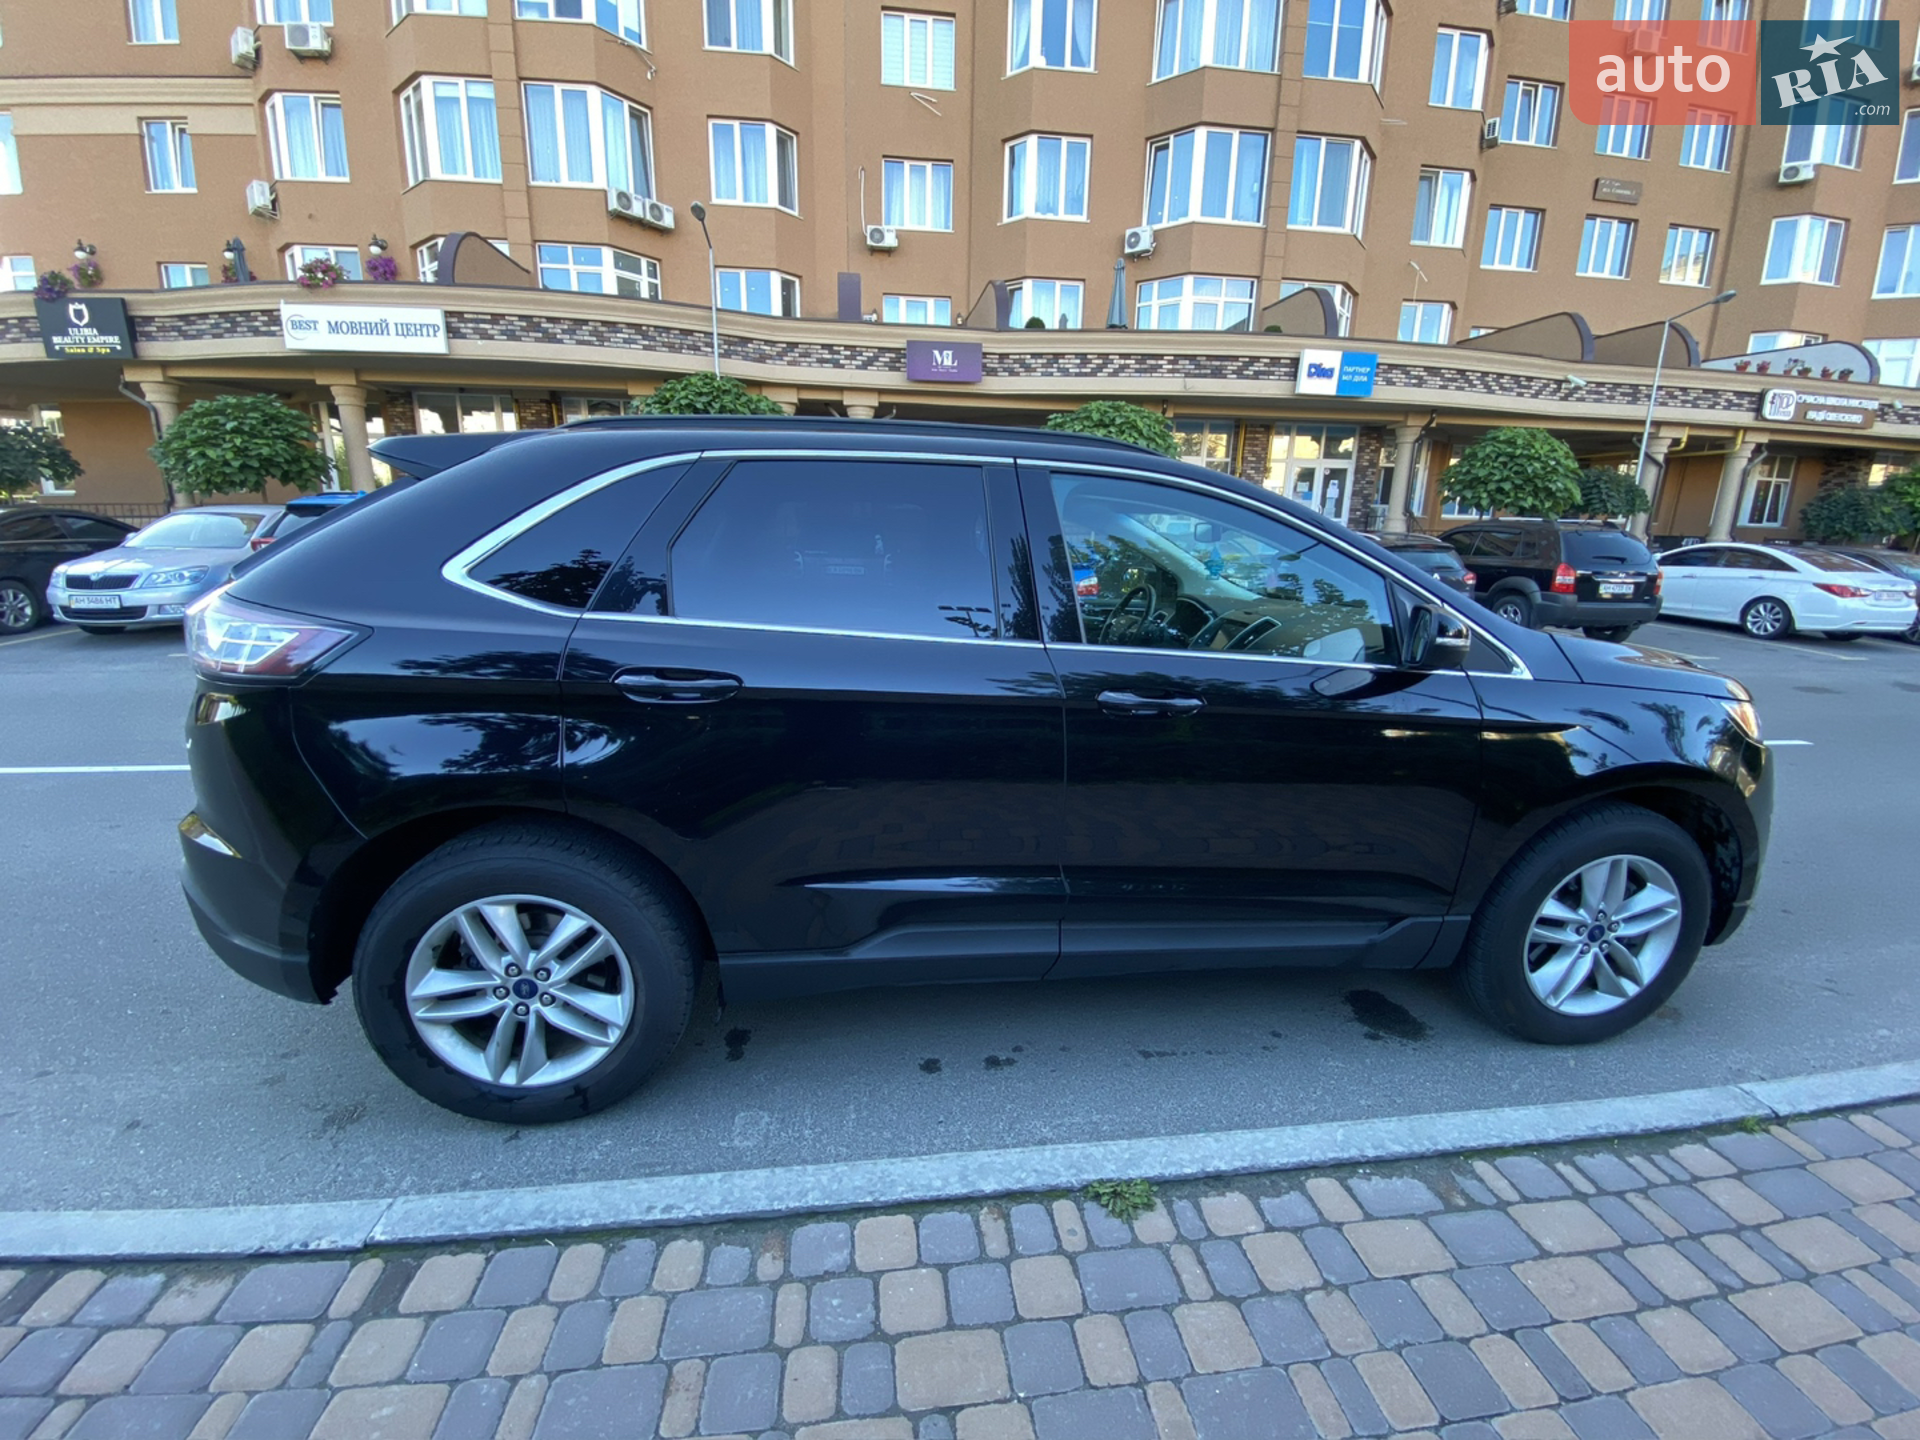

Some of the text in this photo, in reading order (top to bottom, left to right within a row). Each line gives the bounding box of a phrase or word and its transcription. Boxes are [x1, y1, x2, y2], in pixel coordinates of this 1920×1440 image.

[290, 319, 319, 331] BEST
[327, 318, 441, 339] МОВНИЙ ЦЕНТР
[52, 335, 121, 344] BEAUTY EMPIRE
[1343, 365, 1372, 374] ПАРТНЕР
